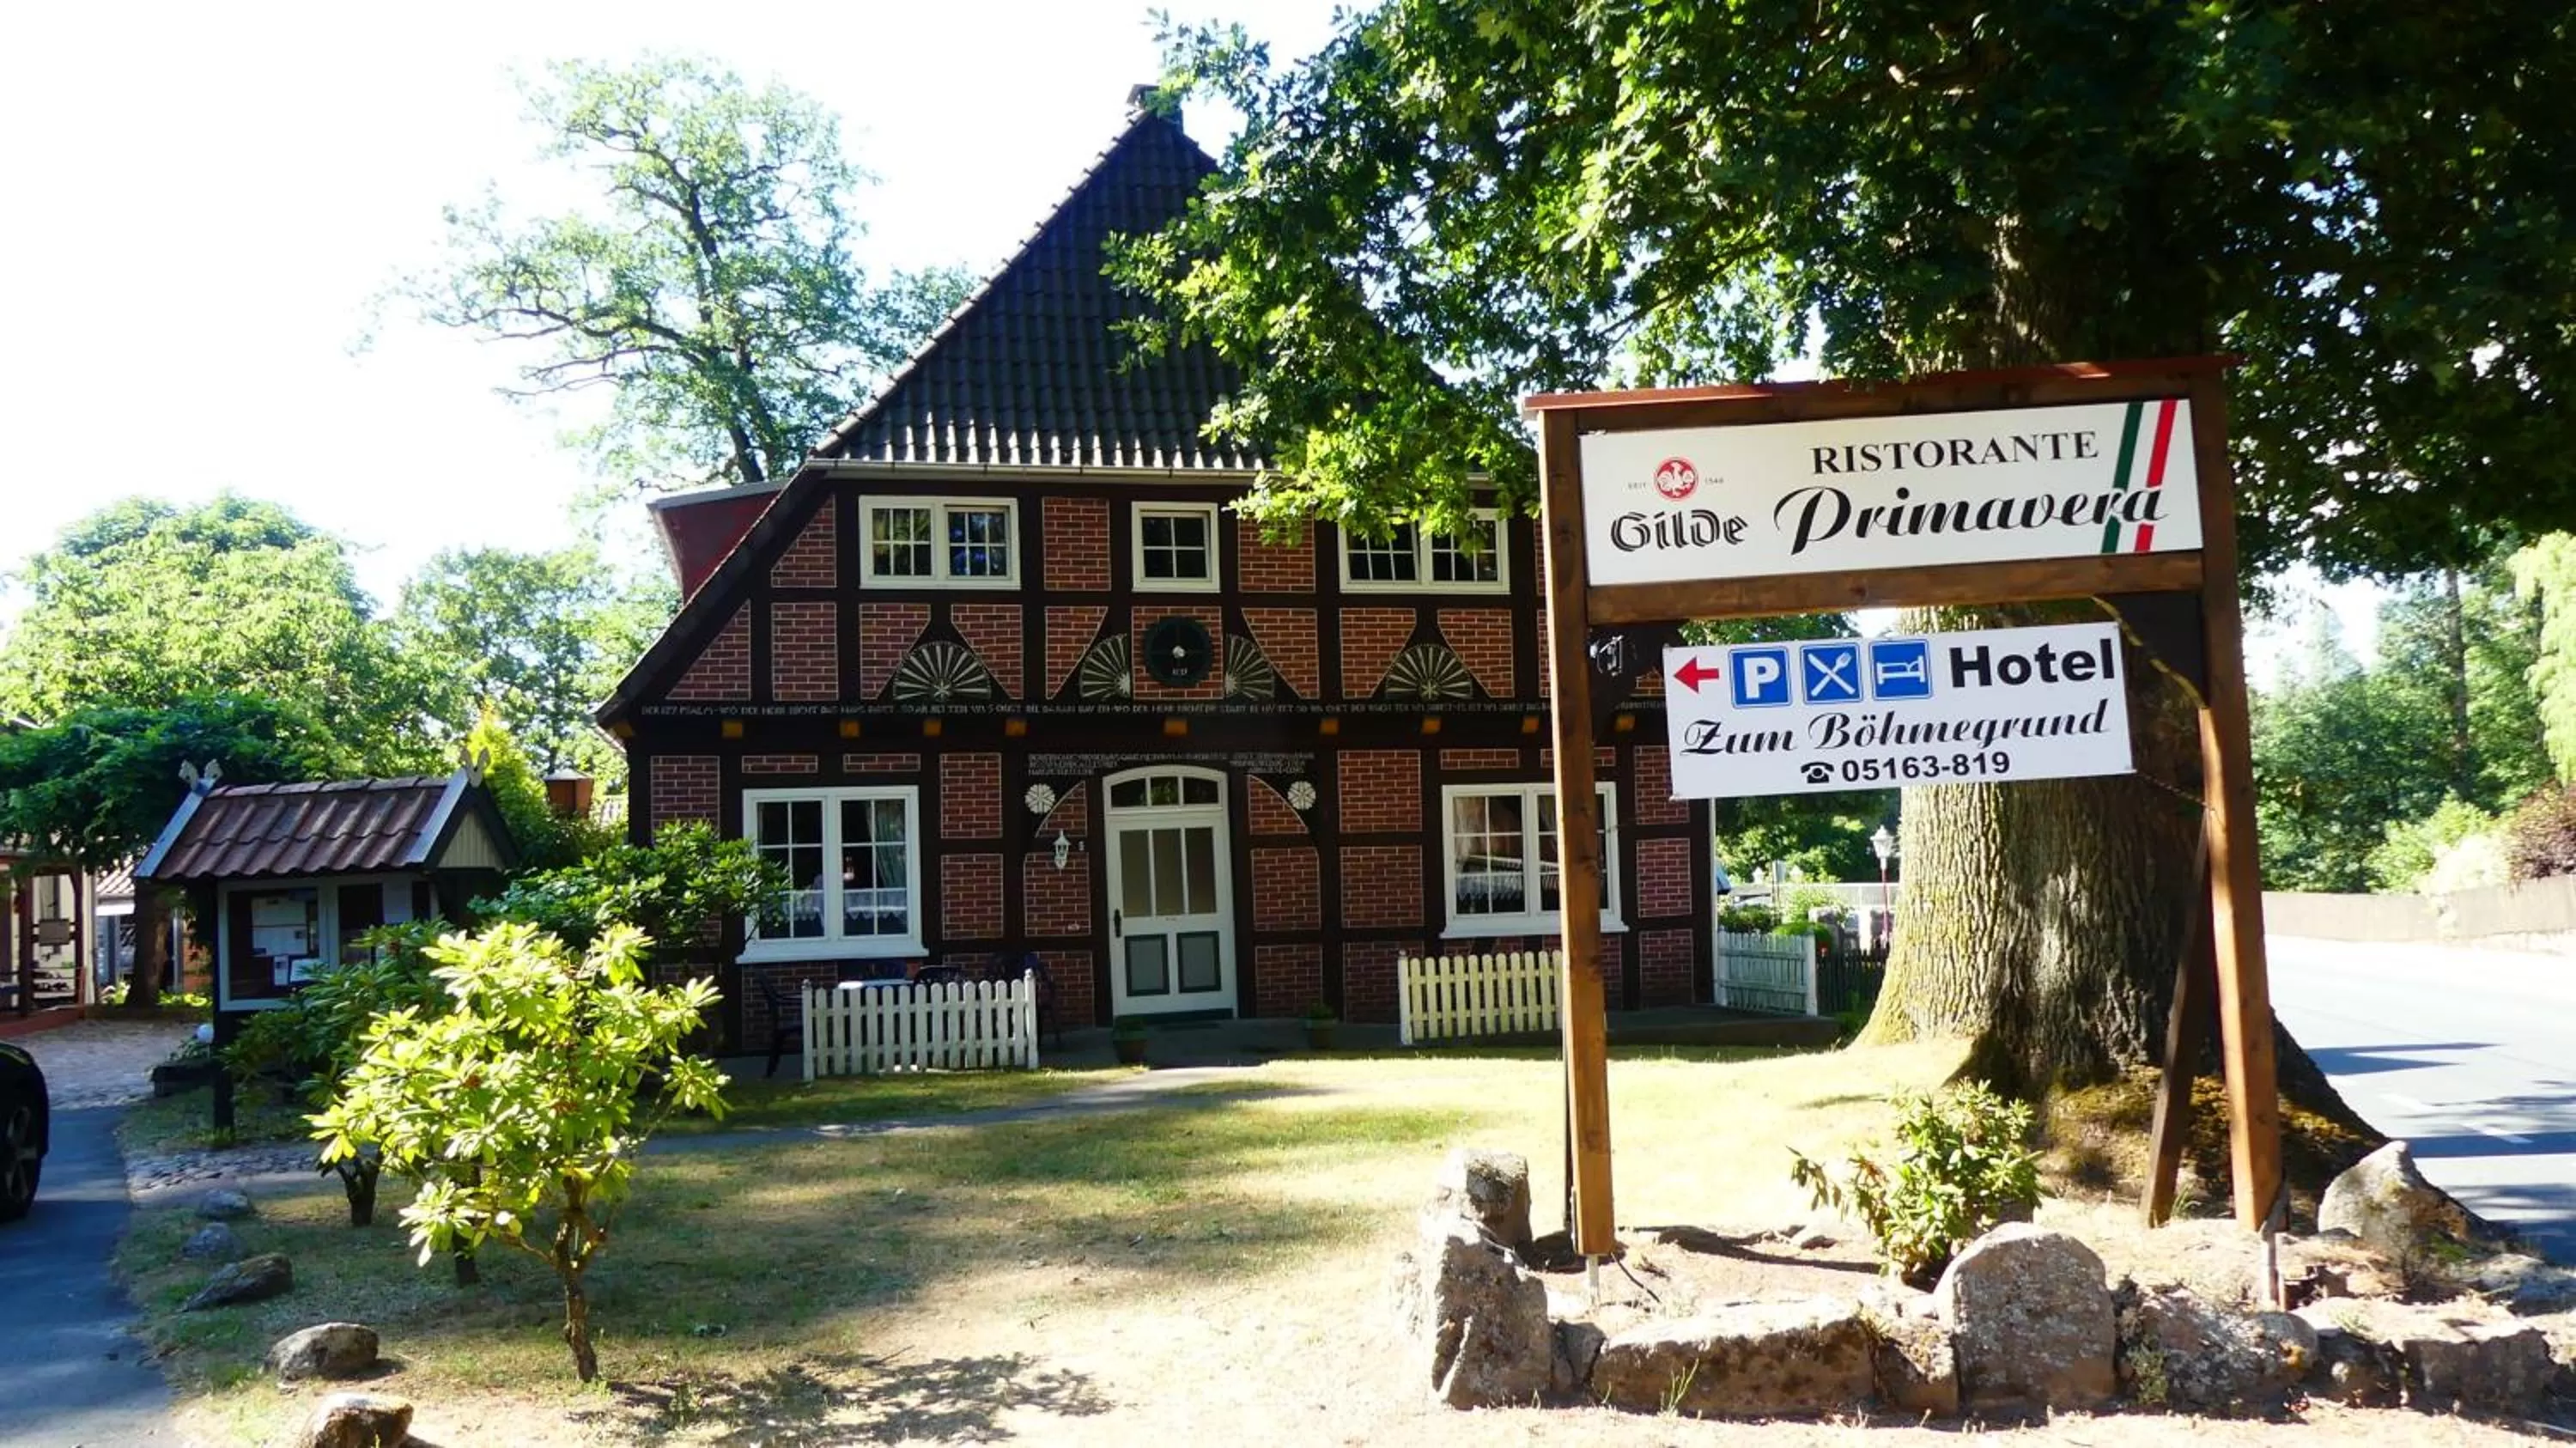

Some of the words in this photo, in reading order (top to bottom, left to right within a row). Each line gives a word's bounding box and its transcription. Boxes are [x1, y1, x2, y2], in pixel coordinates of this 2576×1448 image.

[1811, 431, 2099, 474] RISTORANTE
[1610, 509, 1748, 552] Gilde
[1773, 486, 2170, 556] Primavera
[1743, 657, 1780, 699] P
[1949, 638, 2115, 688] Hotel
[1680, 719, 1797, 756] Zum
[1807, 698, 2110, 749] Böhmegrund
[1842, 751, 2010, 782] 05163-819
